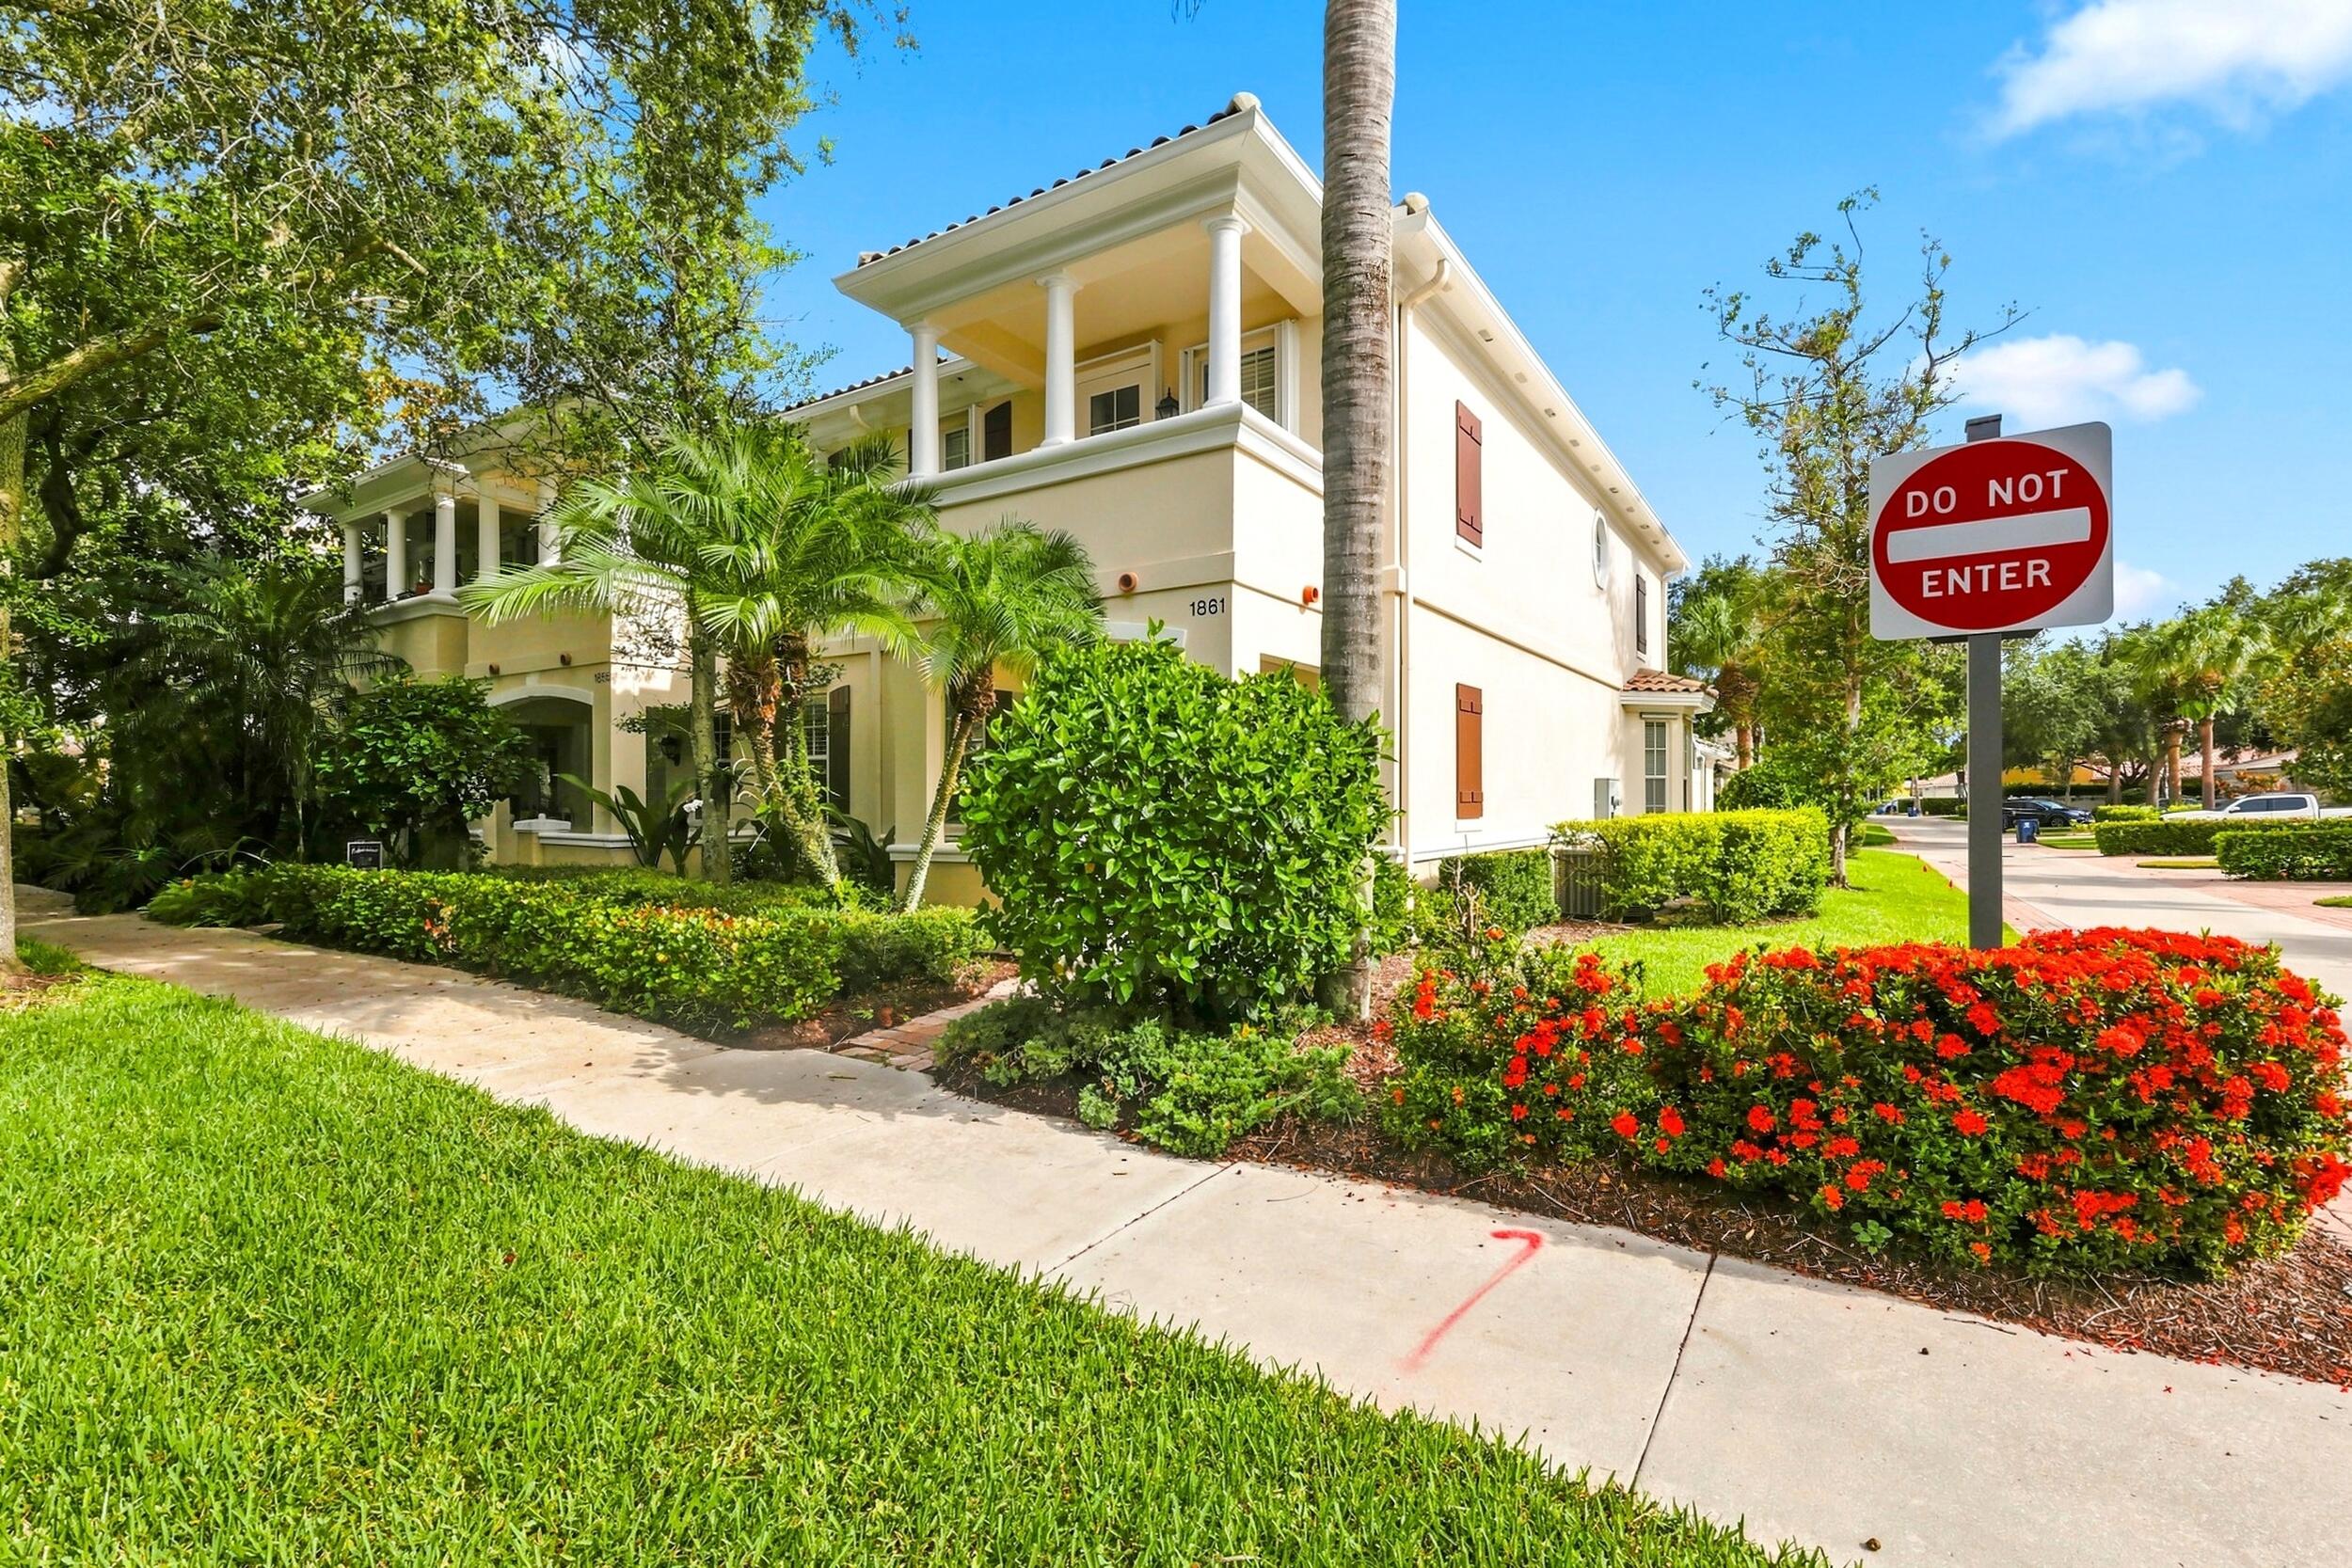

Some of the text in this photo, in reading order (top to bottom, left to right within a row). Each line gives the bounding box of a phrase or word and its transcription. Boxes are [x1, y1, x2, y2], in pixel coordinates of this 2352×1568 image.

[1906, 468, 2069, 517] DO NOT
[1922, 559, 2052, 598] ENTER
[1189, 597, 1225, 617] 1861
